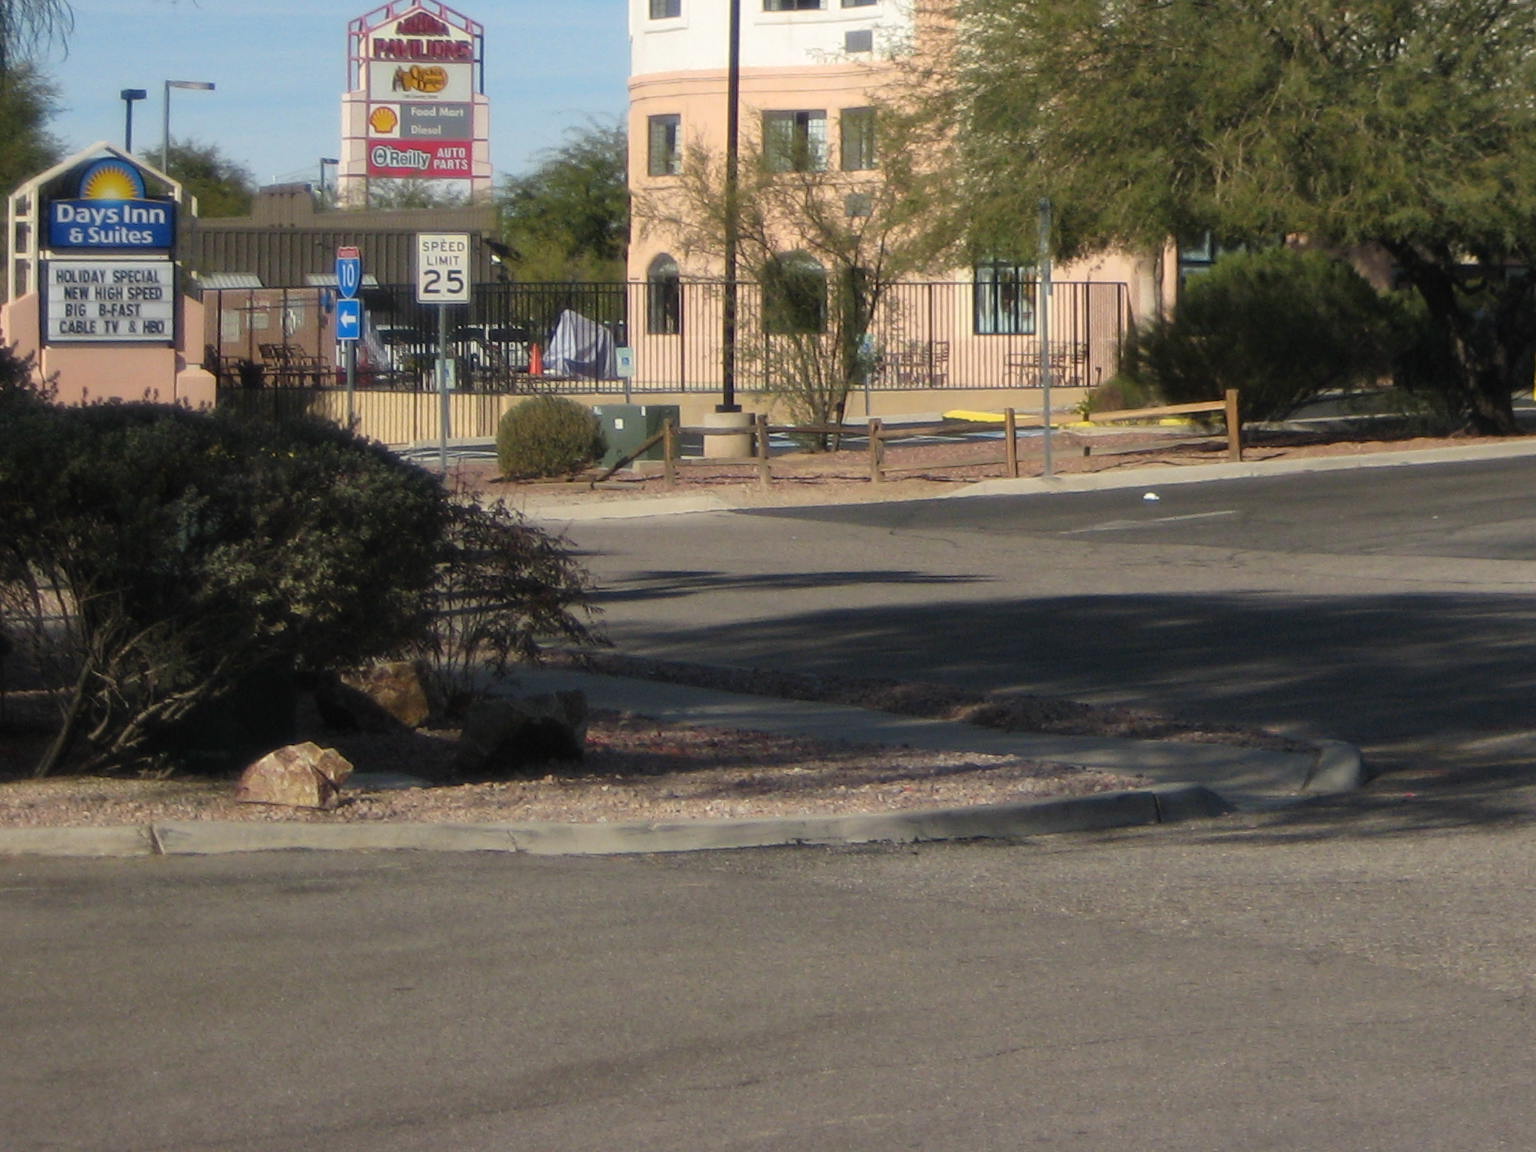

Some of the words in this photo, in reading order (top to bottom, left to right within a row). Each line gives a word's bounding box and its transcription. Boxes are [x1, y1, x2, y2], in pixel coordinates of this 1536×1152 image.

[411, 106, 436, 117] Food
[439, 107, 464, 117] Mart
[410, 125, 442, 135] Diesel
[373, 146, 430, 169] O'Reilly
[437, 147, 466, 158] AUTO
[433, 159, 469, 170] PARTS
[56, 204, 119, 225] Days
[123, 205, 165, 224] Inn
[69, 228, 84, 243] &
[88, 227, 153, 244] Suites
[422, 241, 465, 252] SPEED
[426, 255, 460, 266] LIMIT
[56, 270, 106, 283] HOLIDAY
[112, 270, 160, 283] SPECIAL
[342, 263, 355, 287] 10
[423, 269, 464, 294] 25
[64, 287, 89, 300] NEW
[95, 287, 123, 300] HIGH
[127, 288, 163, 300] SPEED
[65, 303, 87, 317] BIG
[98, 303, 141, 317] B-FAST
[60, 320, 96, 334] CABLE
[104, 321, 119, 334] TV
[128, 321, 137, 333] &
[142, 321, 165, 334] HBO
